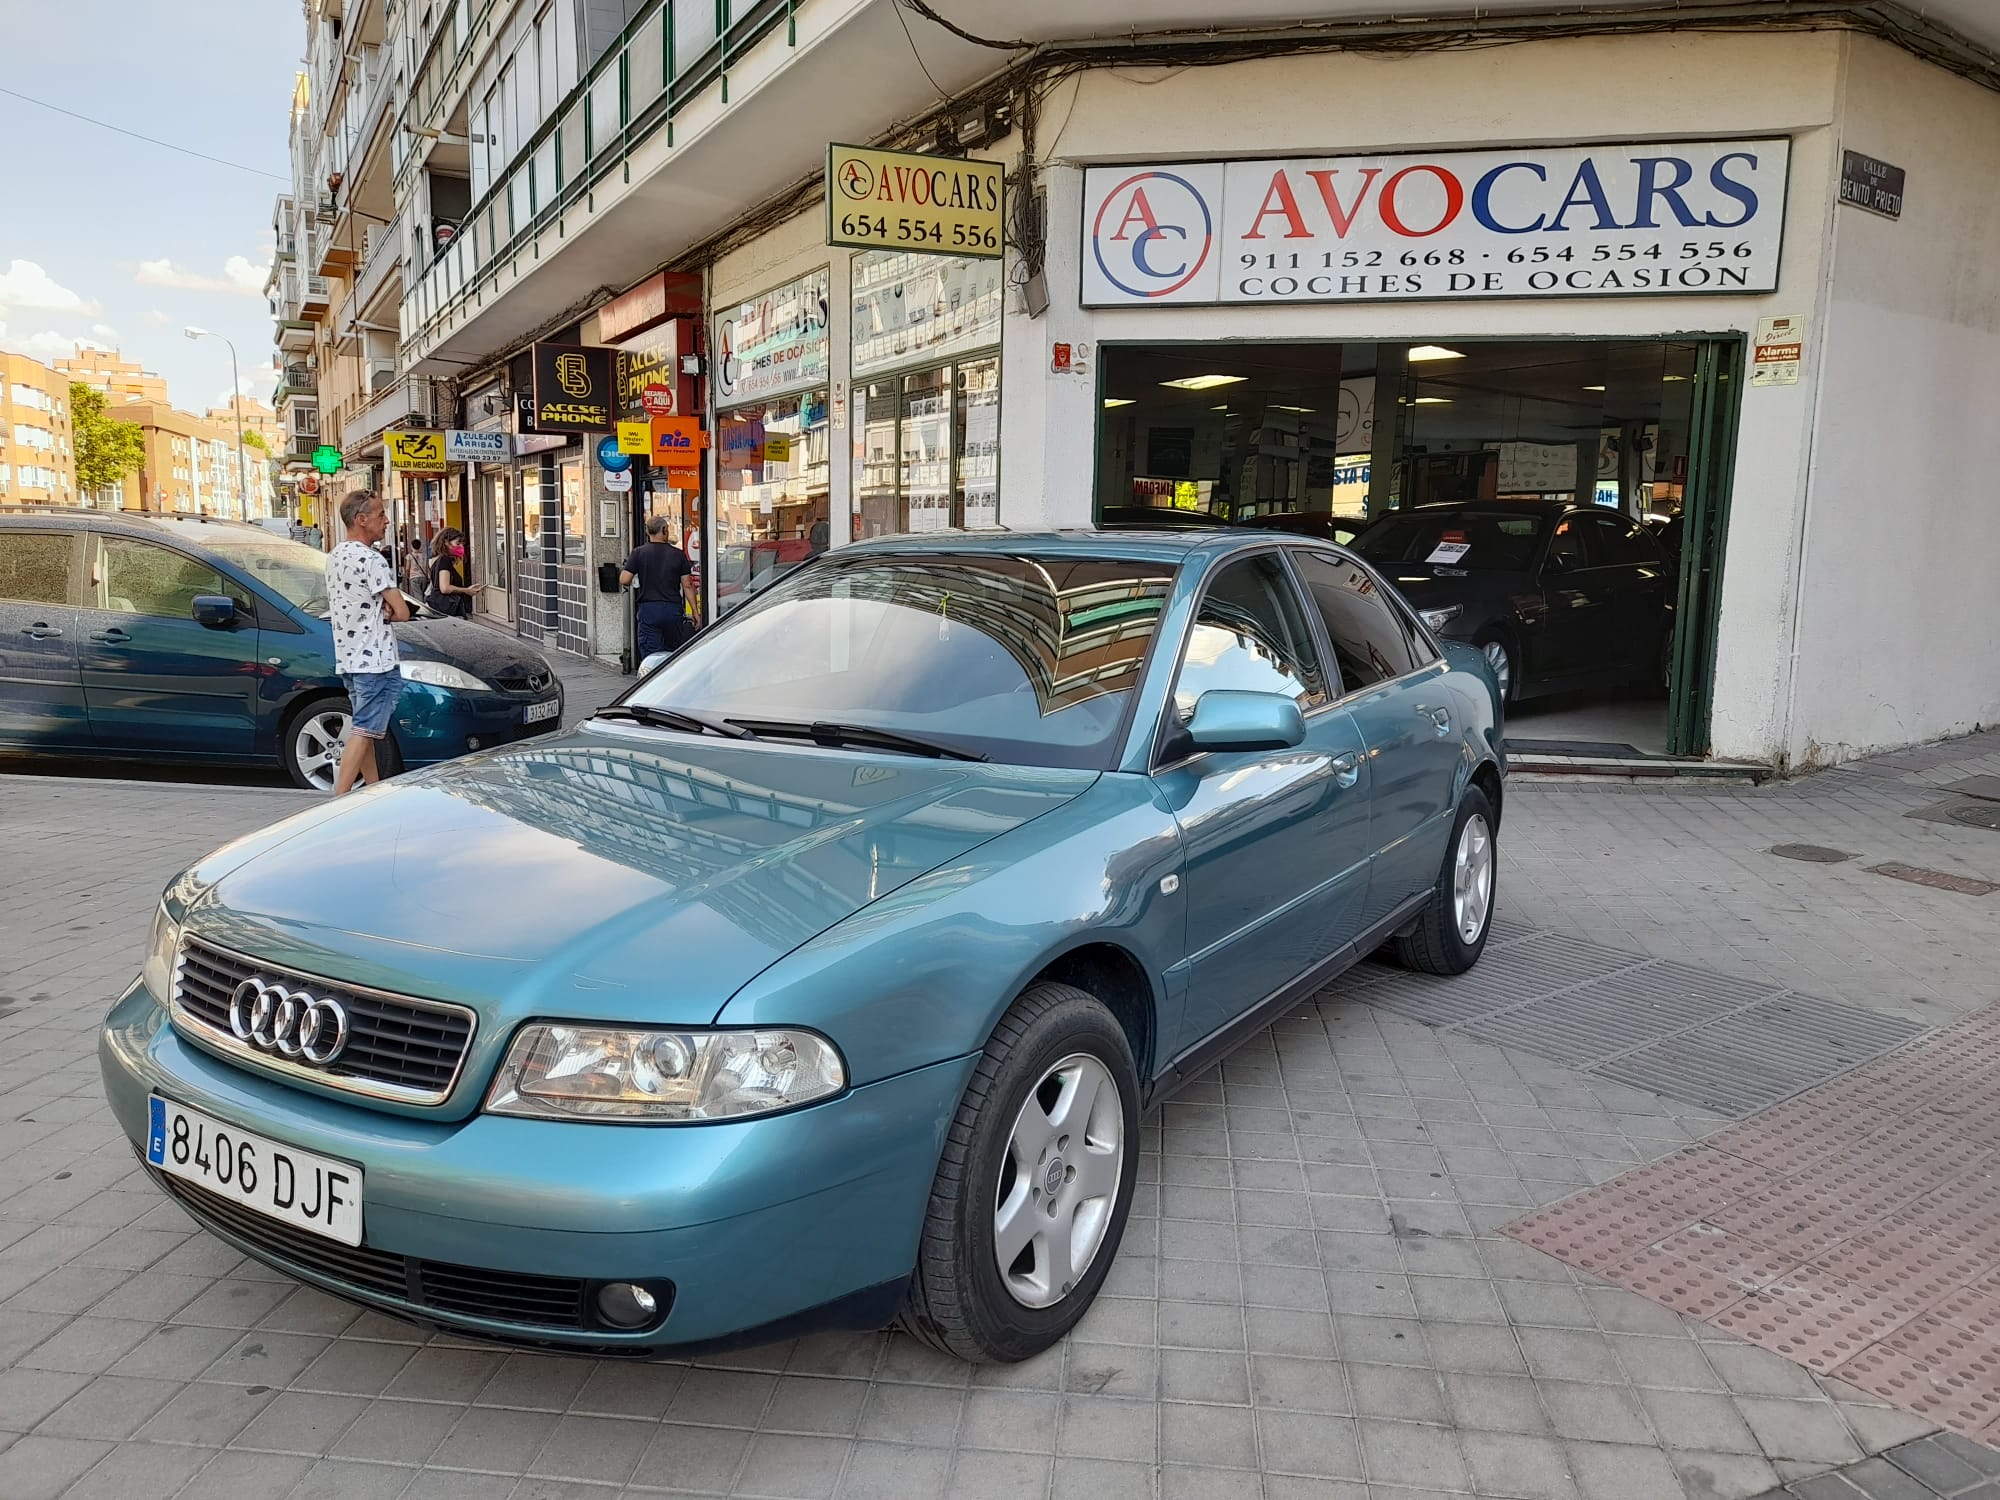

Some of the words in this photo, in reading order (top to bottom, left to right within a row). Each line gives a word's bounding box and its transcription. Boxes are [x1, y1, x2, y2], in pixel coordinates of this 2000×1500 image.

[1863, 160, 1887, 178] CALLE
[877, 164, 997, 212] AVOCARS
[1241, 152, 1759, 239] AVOCARS
[1841, 178, 1870, 204] BENITO
[1874, 189, 1901, 214] PRIETO
[841, 214, 887, 238] 654
[897, 218, 942, 243] 554
[952, 224, 997, 248] 556
[1240, 252, 1302, 270] 911
[1321, 250, 1383, 268] 152
[1399, 248, 1465, 266] 668
[1507, 245, 1575, 264] 654
[1591, 243, 1663, 262] 554
[1679, 241, 1752, 259] 556
[1239, 274, 1422, 296] COCHES
[1447, 272, 1504, 291] DE
[1528, 262, 1751, 290] OCASIÓN
[773, 350, 785, 364] DE
[1758, 347, 1798, 356] Alarma
[629, 364, 670, 397] PHONE
[541, 412, 607, 425] PHONE
[660, 429, 691, 447] Ria
[153, 1136, 161, 1152] E
[172, 1114, 258, 1194] 8406
[273, 1152, 350, 1225] DJF
